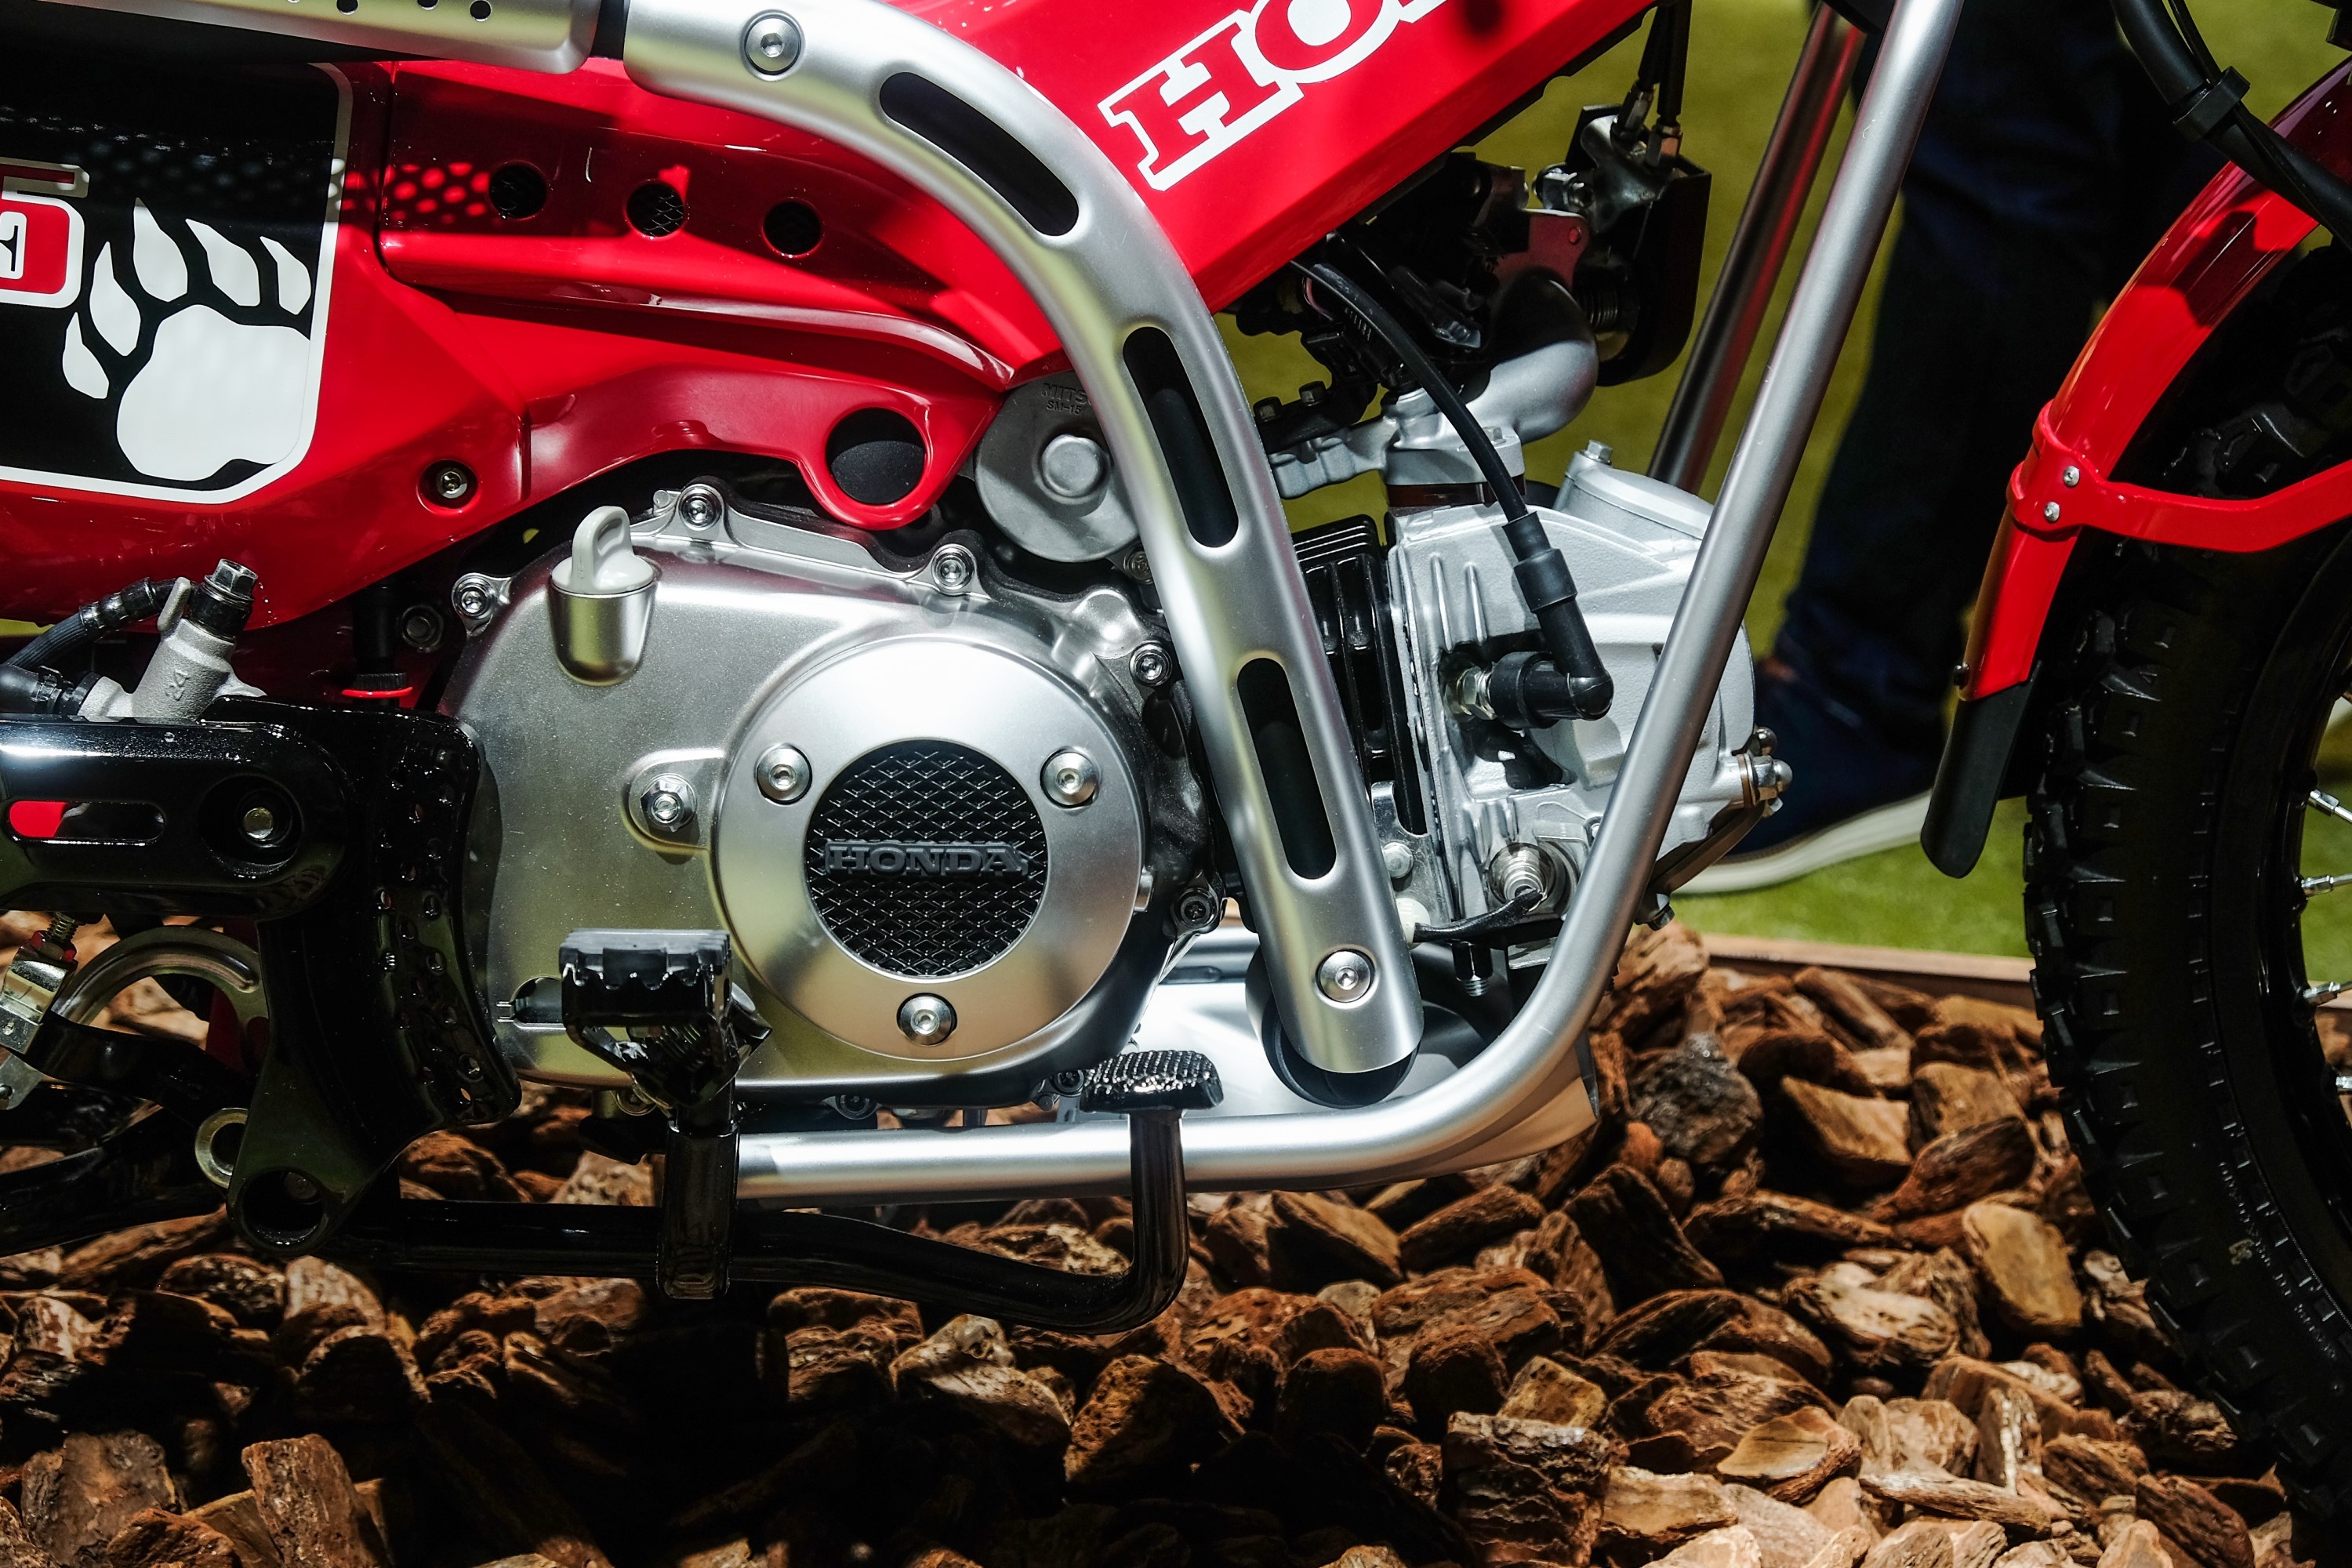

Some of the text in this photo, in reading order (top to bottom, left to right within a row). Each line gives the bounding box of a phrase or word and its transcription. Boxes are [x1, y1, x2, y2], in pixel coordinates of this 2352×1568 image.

[1097, 0, 1449, 192] HO
[1040, 382, 1091, 406] MITS
[1046, 399, 1083, 416] SM-15
[828, 844, 1024, 875] HONDA
